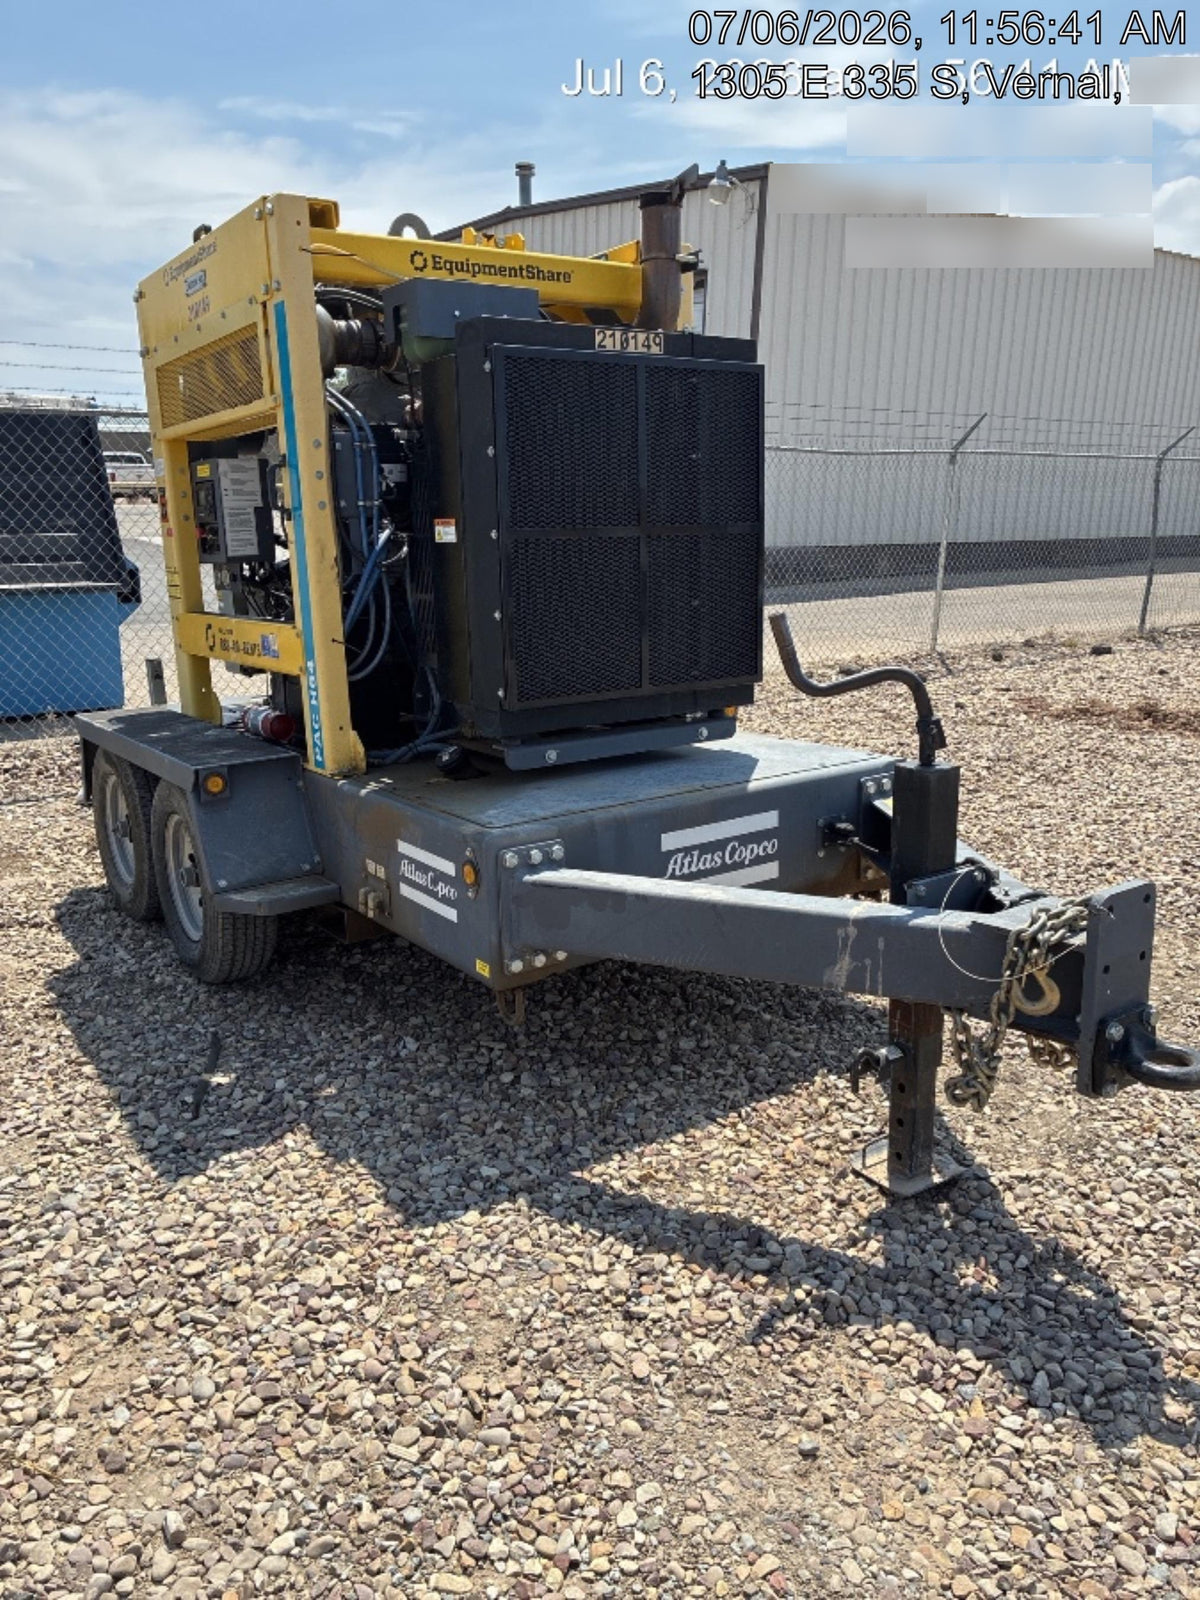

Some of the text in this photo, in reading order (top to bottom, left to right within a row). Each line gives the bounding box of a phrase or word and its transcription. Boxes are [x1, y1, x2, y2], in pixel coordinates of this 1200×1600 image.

[431, 254, 572, 284] EquipmentShare
[596, 329, 663, 353] 210149
[399, 859, 428, 886] Atlas
[664, 838, 779, 879] Atlas Copco
